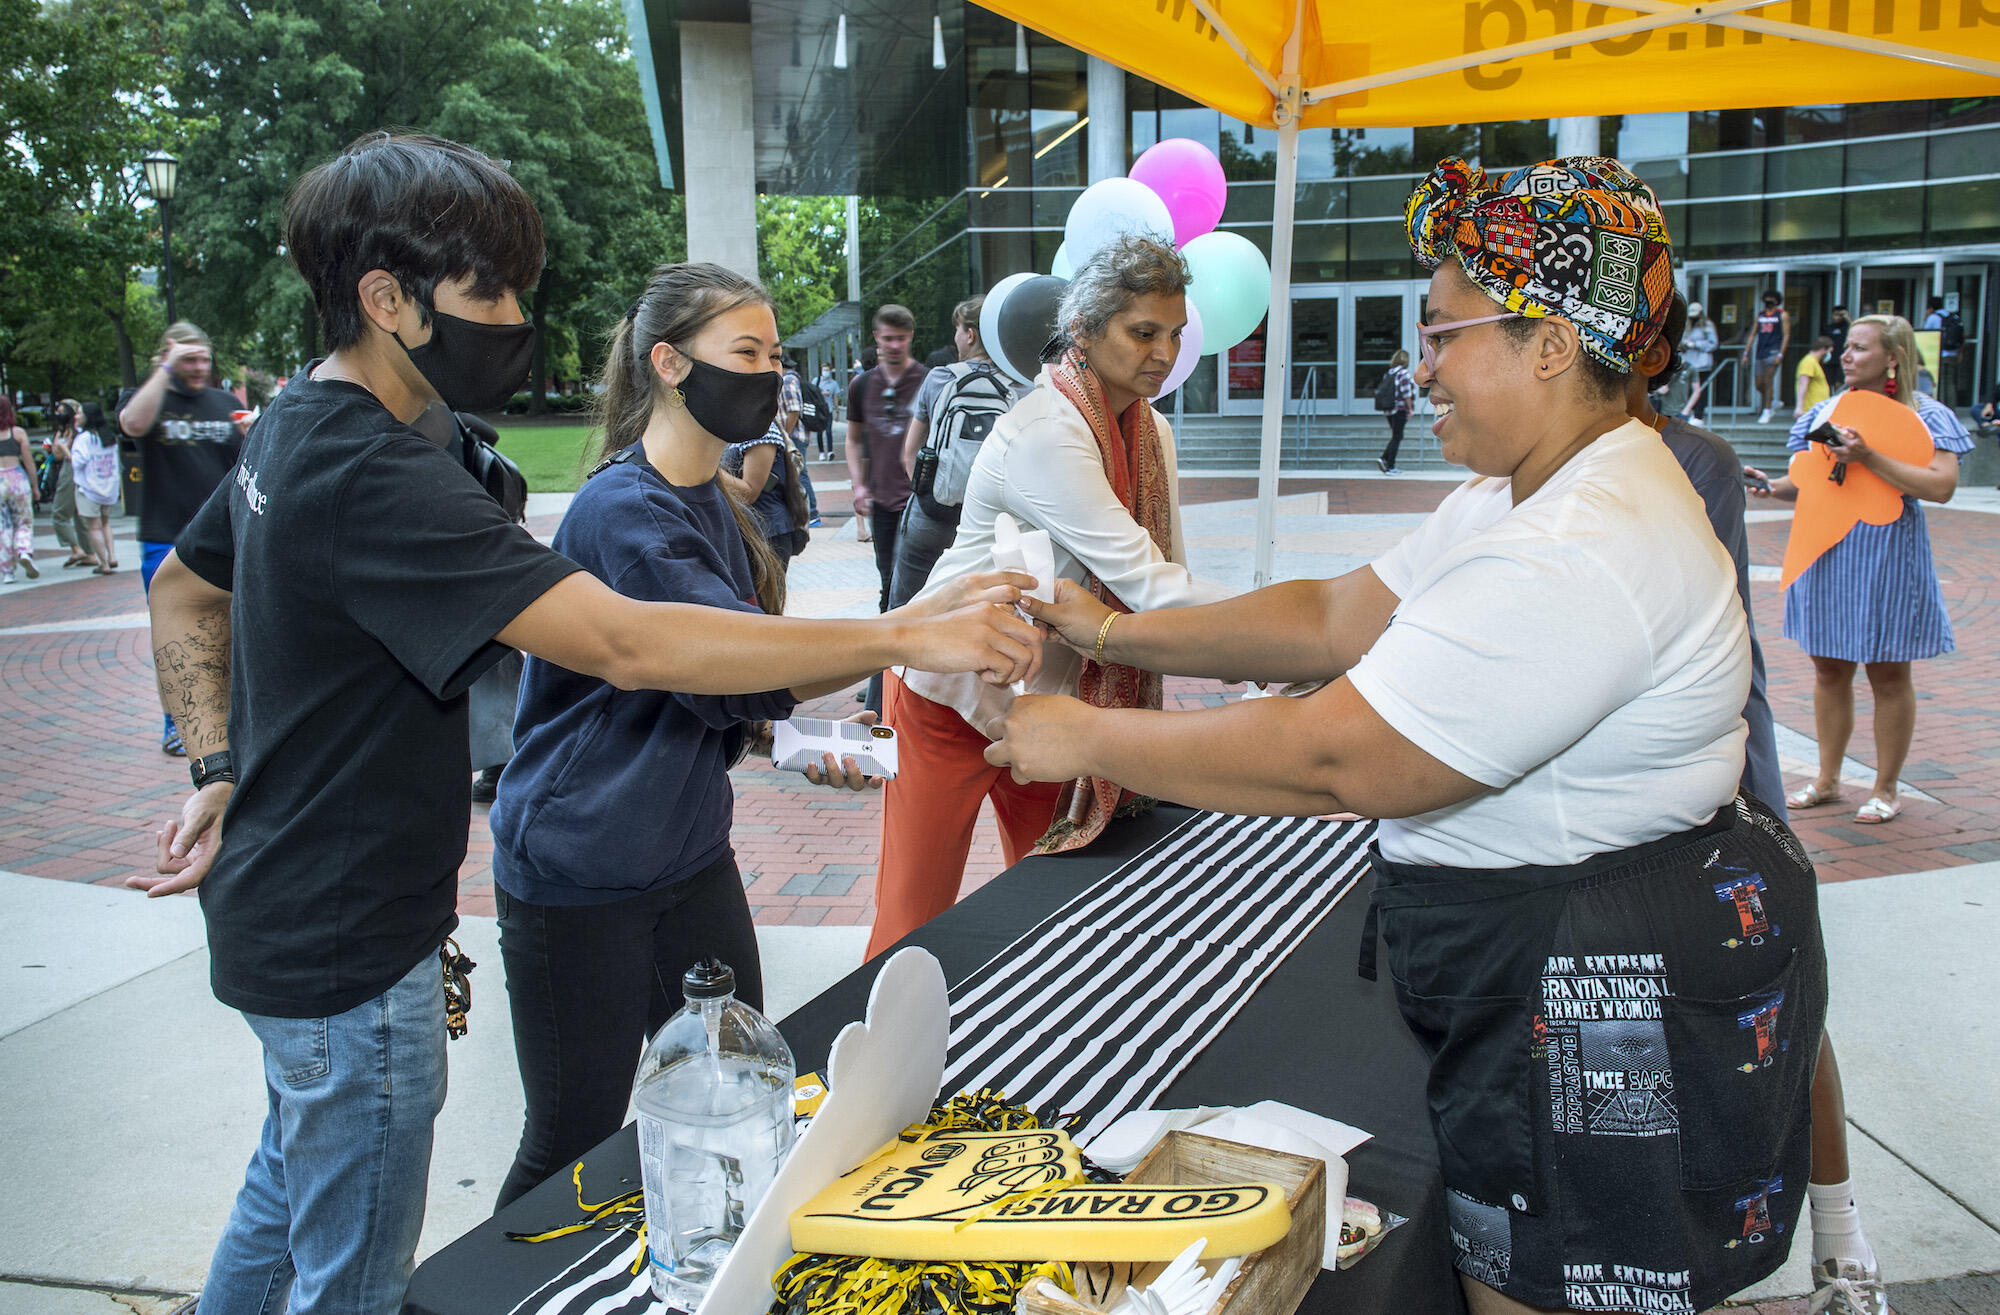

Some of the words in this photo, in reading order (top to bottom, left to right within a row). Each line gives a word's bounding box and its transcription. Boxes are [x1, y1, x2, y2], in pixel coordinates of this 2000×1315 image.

[1543, 956, 1577, 975] ADE
[1584, 954, 1667, 974] EXTREME
[1583, 1071, 1625, 1090] TMIE
[852, 1165, 899, 1197] Alumni
[1163, 1194, 1240, 1214] GO
[1613, 1264, 1691, 1289] EXTREME
